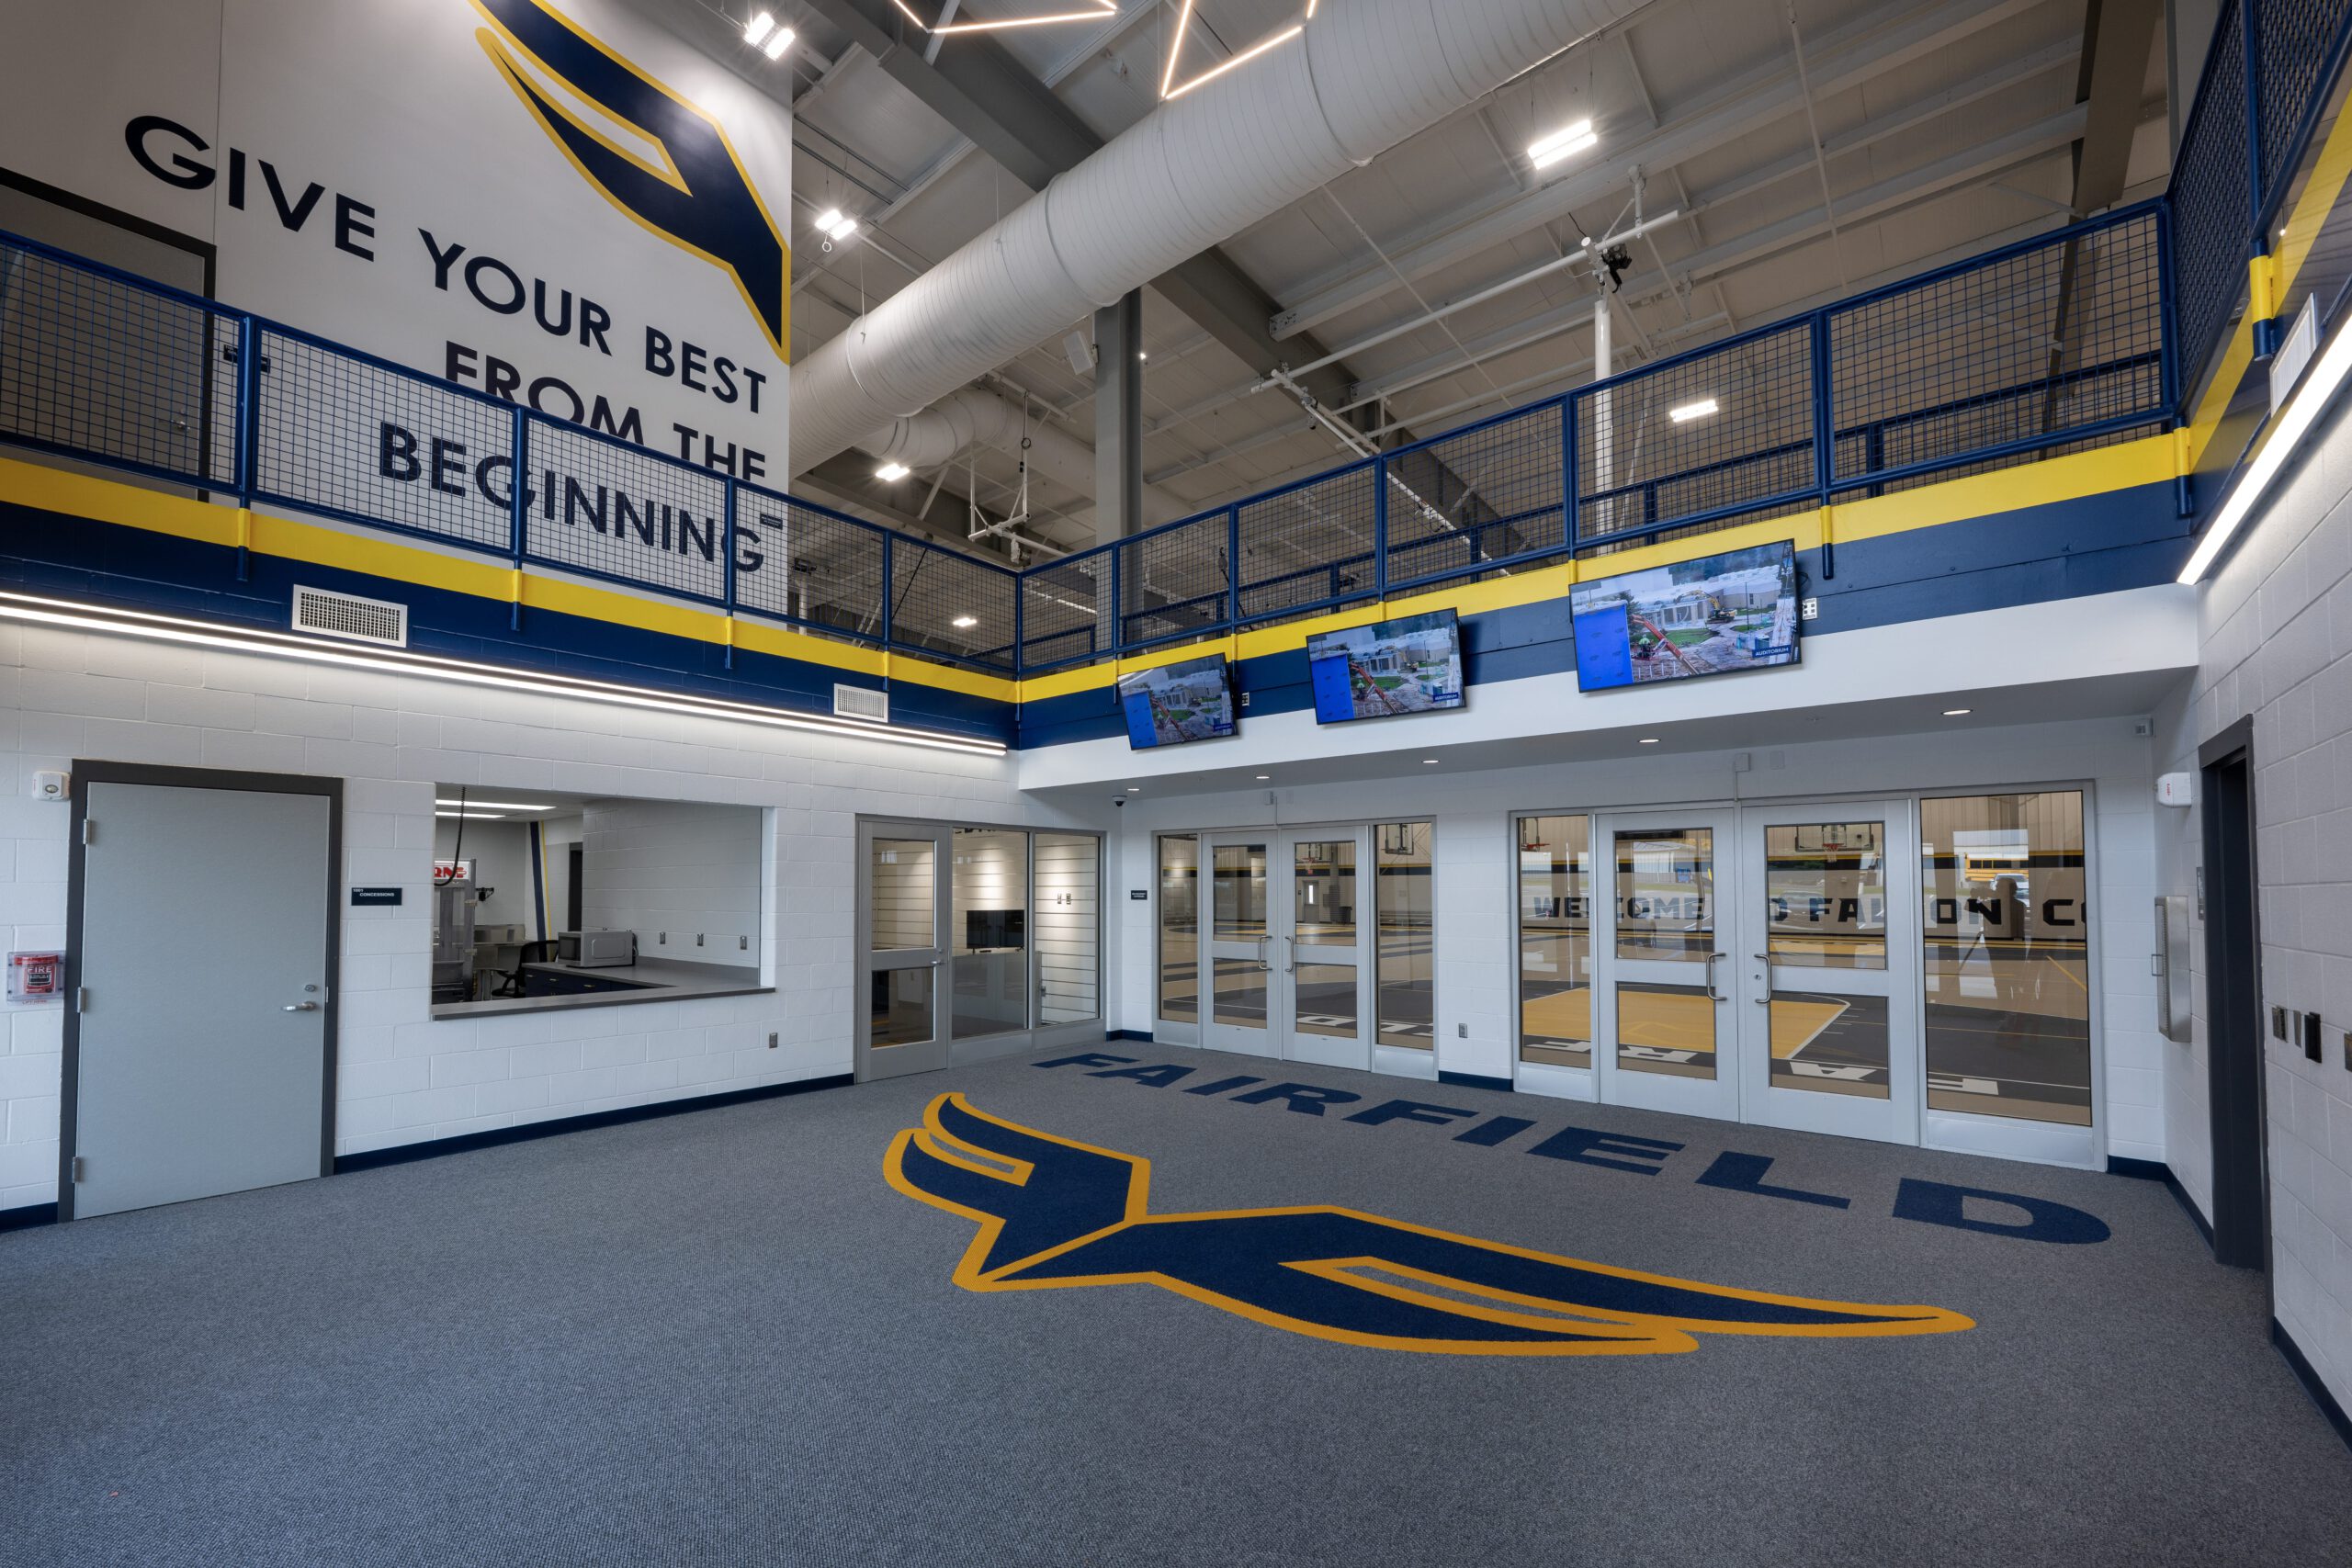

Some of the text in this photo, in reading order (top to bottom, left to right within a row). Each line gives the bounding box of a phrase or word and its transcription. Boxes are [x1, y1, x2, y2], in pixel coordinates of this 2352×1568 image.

[125, 115, 766, 414] GIVE YOUR BEST
[446, 340, 645, 446] FROM
[379, 421, 764, 572] BEGINNING
[1755, 647, 1789, 657] AUDITORIUM
[1533, 897, 1706, 920] WEOME
[1809, 897, 2003, 925] FALON
[2041, 898, 2086, 926] C
[28, 965, 52, 974] FIRE
[1031, 1052, 2111, 1245] FAIRFIELD
